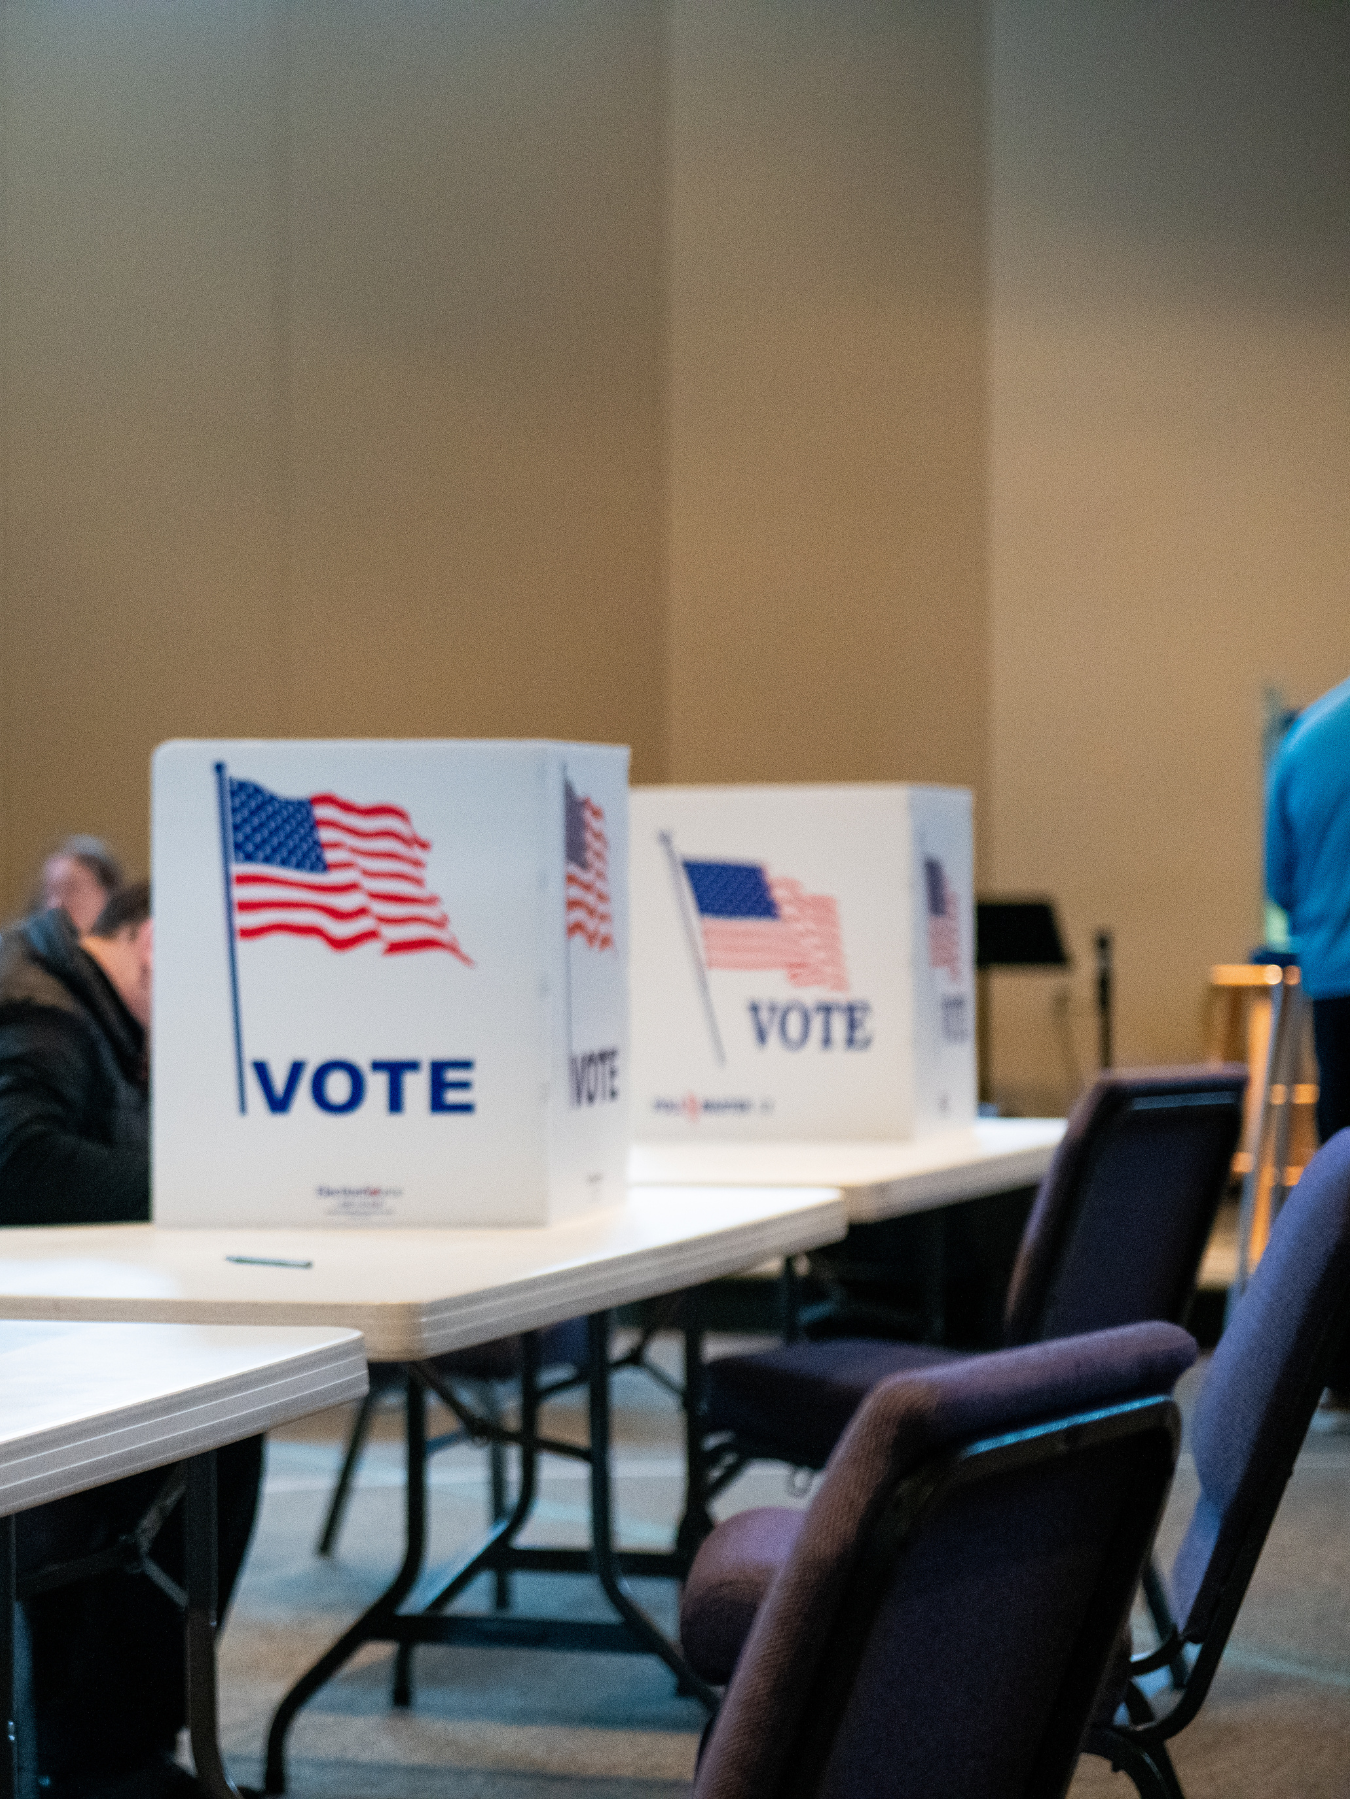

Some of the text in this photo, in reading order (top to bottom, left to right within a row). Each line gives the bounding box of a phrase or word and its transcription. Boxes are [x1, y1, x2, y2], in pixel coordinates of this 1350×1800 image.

[749, 999, 873, 1051] VOTE
[252, 1060, 476, 1116] VOTE
[569, 1048, 618, 1107] VOTE
